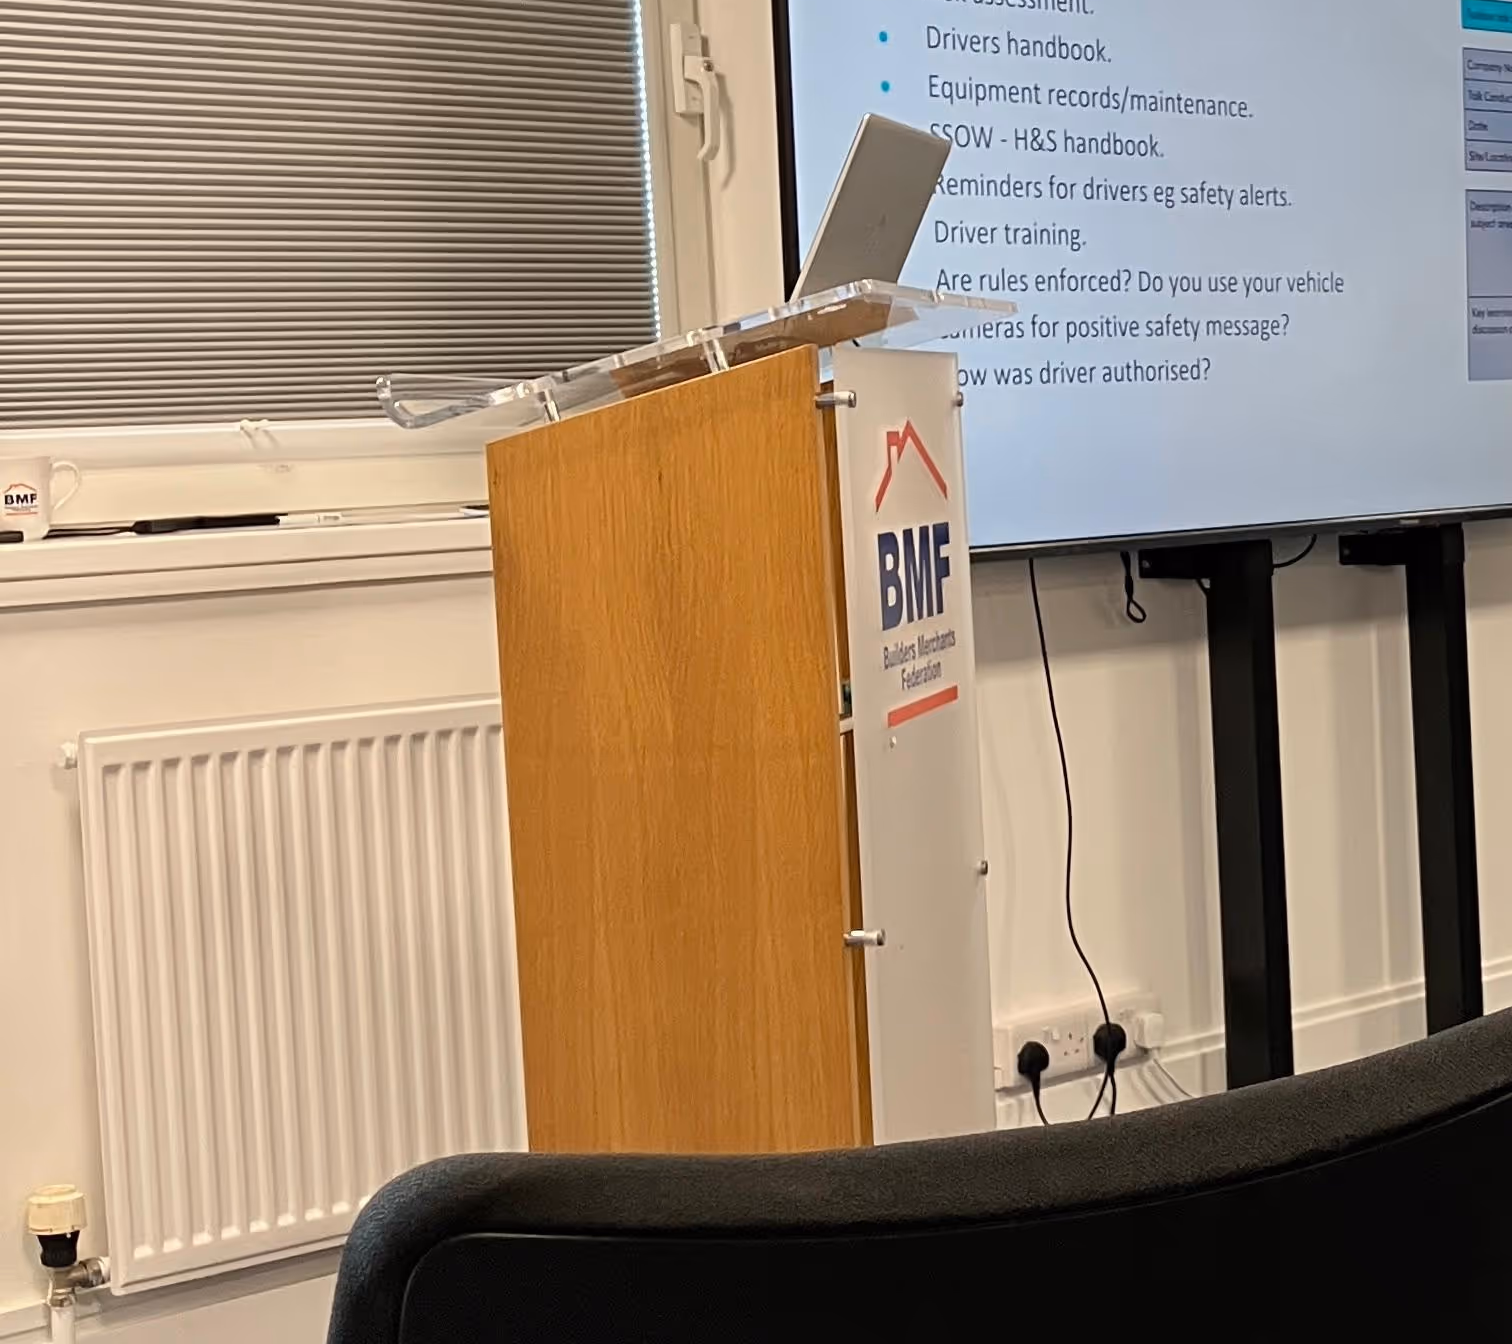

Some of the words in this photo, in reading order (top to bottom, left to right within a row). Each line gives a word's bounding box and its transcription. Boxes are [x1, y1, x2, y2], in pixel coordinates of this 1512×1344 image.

[927, 26, 1000, 54] Drivers
[1007, 31, 1111, 62] handbook.
[929, 75, 1041, 106] Equipment
[1049, 86, 1253, 117] records/maintenance.
[1015, 128, 1057, 152] H&S
[1064, 129, 1164, 157] handbook.
[1049, 175, 1076, 200] for
[1084, 176, 1147, 202] drivers
[1154, 186, 1175, 208] eg
[1181, 181, 1234, 210] safety
[1240, 184, 1291, 206] alerts.
[935, 220, 997, 244] Driver
[1005, 222, 1086, 251] training.
[937, 268, 972, 292] Are
[980, 268, 1028, 292] rules
[1035, 268, 1131, 292] enforced?
[1139, 271, 1163, 292] Do
[1169, 276, 1201, 297] you
[1209, 276, 1237, 292] use
[1243, 277, 1282, 298] your
[1287, 271, 1344, 293] vehicle
[1031, 314, 1059, 337] for
[1067, 315, 1139, 343] positive
[1146, 314, 1200, 342] safety
[1207, 314, 1289, 341] message?
[957, 368, 987, 386] ow
[994, 368, 1032, 385] was
[1040, 360, 1096, 384] driver
[1103, 358, 1210, 382] authorised?
[4, 493, 37, 505] BMF
[877, 521, 951, 632] BMF
[883, 640, 916, 670] Builders
[917, 628, 956, 660] Merchants
[901, 659, 942, 691] Federation
